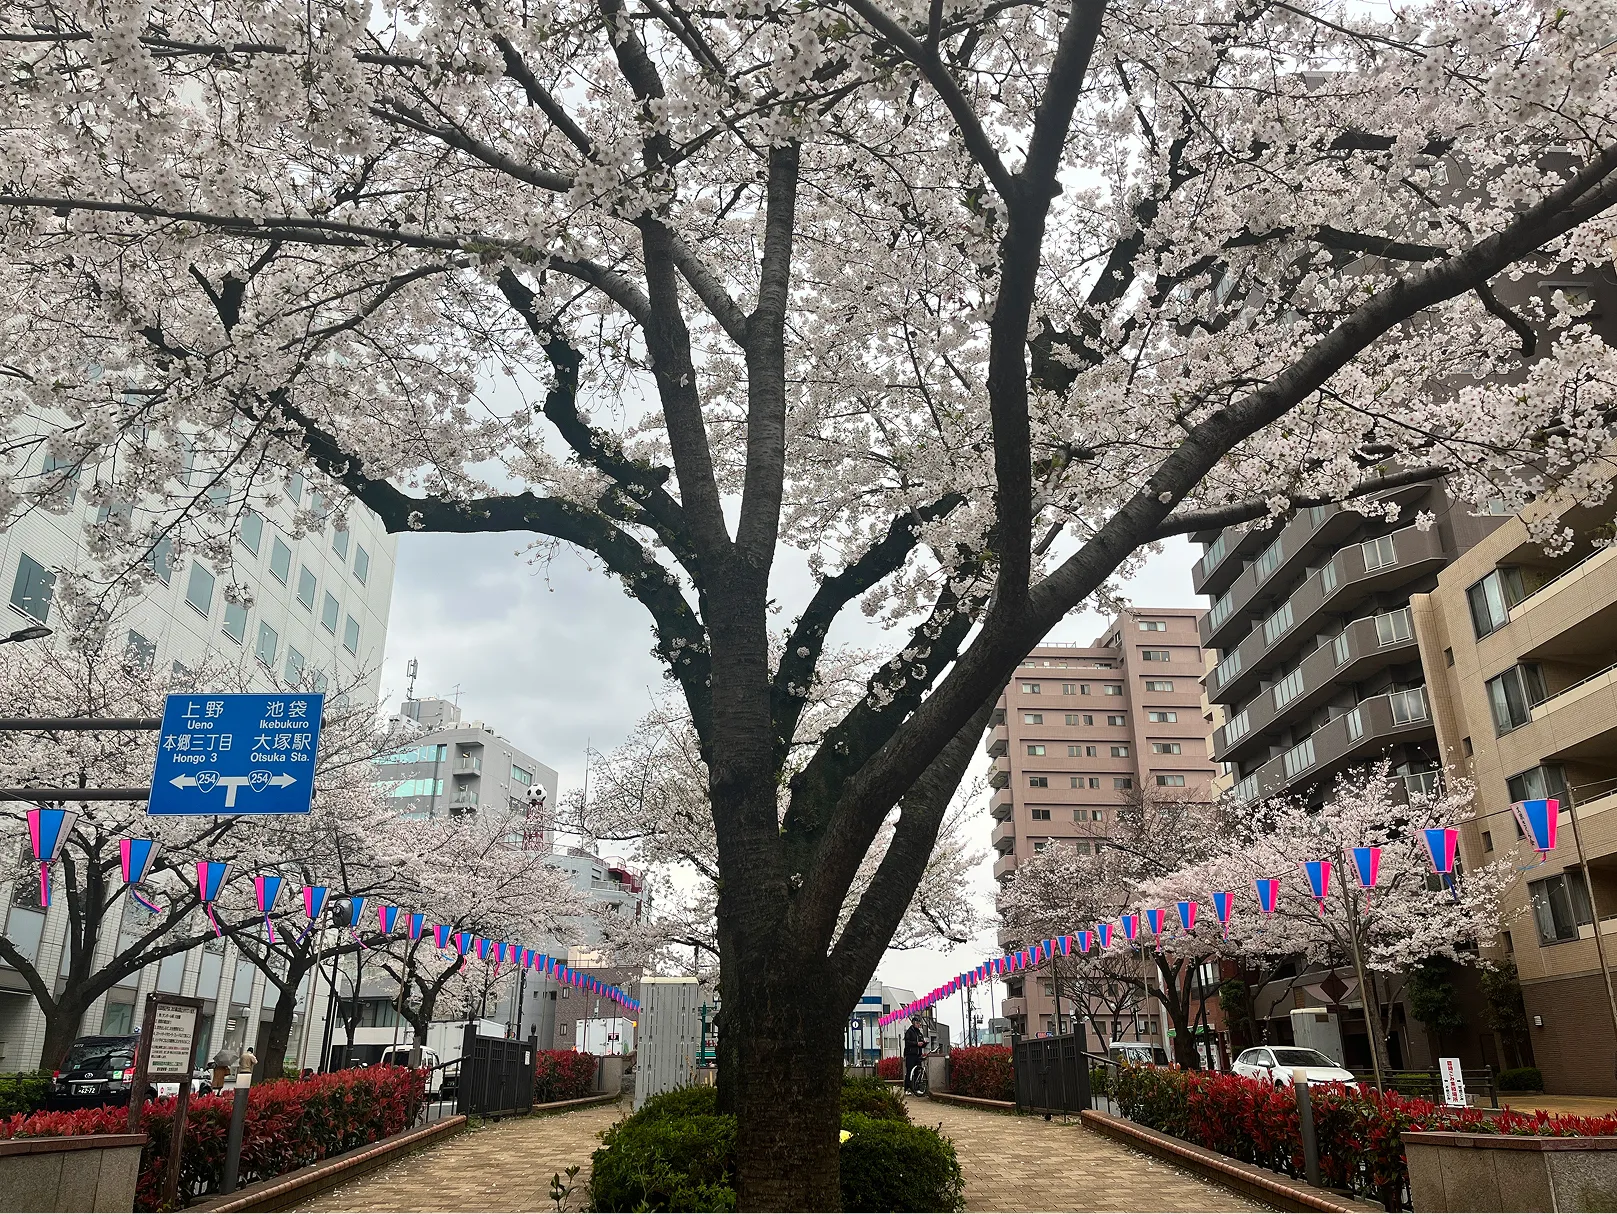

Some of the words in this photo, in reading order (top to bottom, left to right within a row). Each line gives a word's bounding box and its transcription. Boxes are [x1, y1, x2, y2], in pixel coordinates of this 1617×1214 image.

[181, 701, 224, 718] 上野
[265, 701, 307, 718] 池袋
[187, 720, 213, 729] Ueno
[260, 720, 309, 729] Ikebukuro
[163, 734, 232, 751] 本郷三丁目
[252, 734, 312, 751] 大塚駅
[173, 753, 205, 764] Hongo
[210, 752, 218, 762] 3
[250, 752, 286, 762] Otsuka
[290, 752, 310, 762] Sta.
[198, 773, 216, 783] 254
[251, 773, 268, 783] 254
